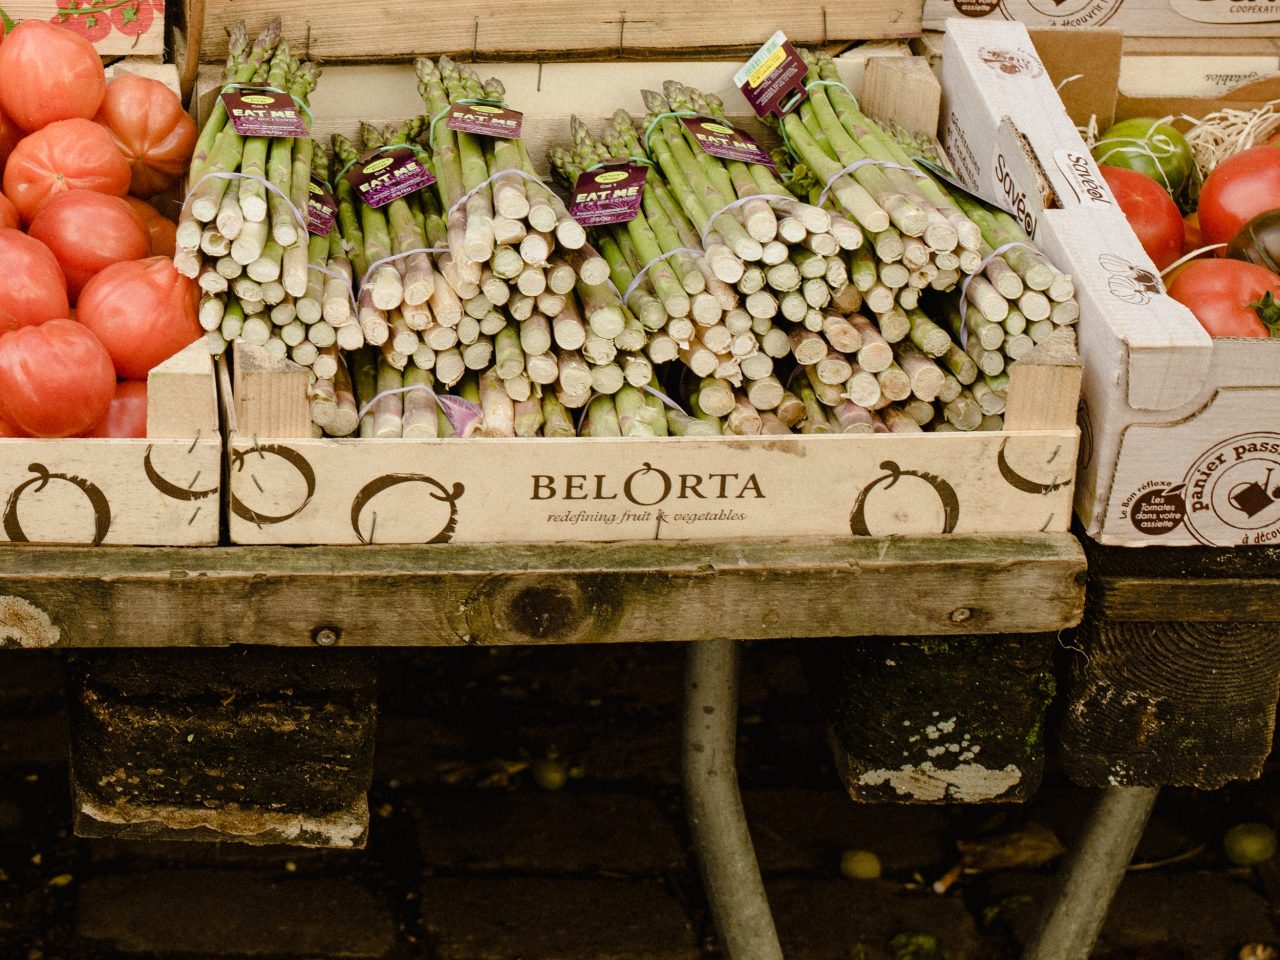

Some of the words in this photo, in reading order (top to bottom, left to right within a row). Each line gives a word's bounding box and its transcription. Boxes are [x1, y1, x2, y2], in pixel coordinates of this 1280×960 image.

[232, 108, 267, 118] EAT
[270, 110, 297, 119] ME
[359, 173, 391, 193] EAT
[393, 161, 419, 178] ME
[576, 190, 612, 203] EAT
[612, 186, 640, 198] ME
[529, 461, 767, 507] BELORTA
[1191, 452, 1227, 513] panier
[1232, 442, 1280, 461] pass
[546, 509, 618, 526] redefining
[618, 509, 652, 525] fruit
[673, 509, 749, 525] vegetables
